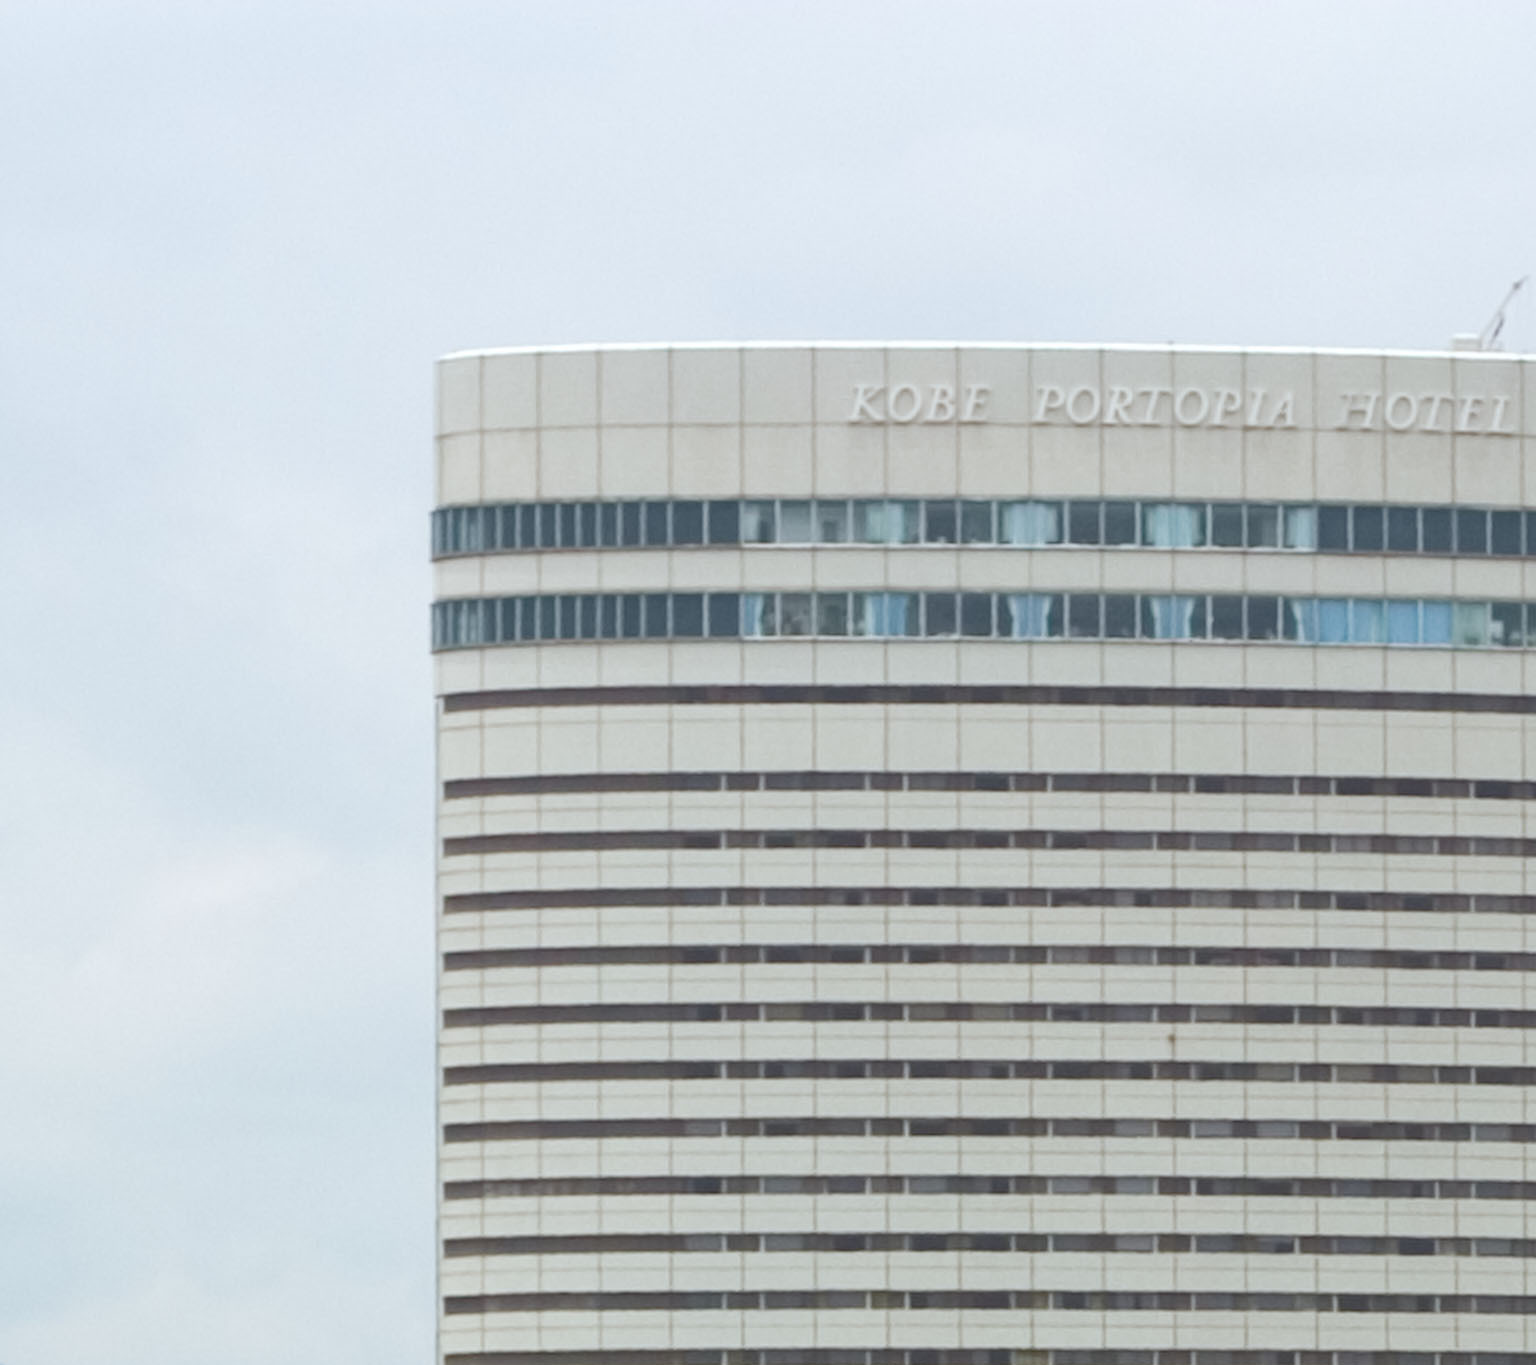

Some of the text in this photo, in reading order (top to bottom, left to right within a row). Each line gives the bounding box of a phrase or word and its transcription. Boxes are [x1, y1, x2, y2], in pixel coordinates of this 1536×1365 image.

[848, 383, 1515, 434] KOBE PORTOPIA HOTEL
